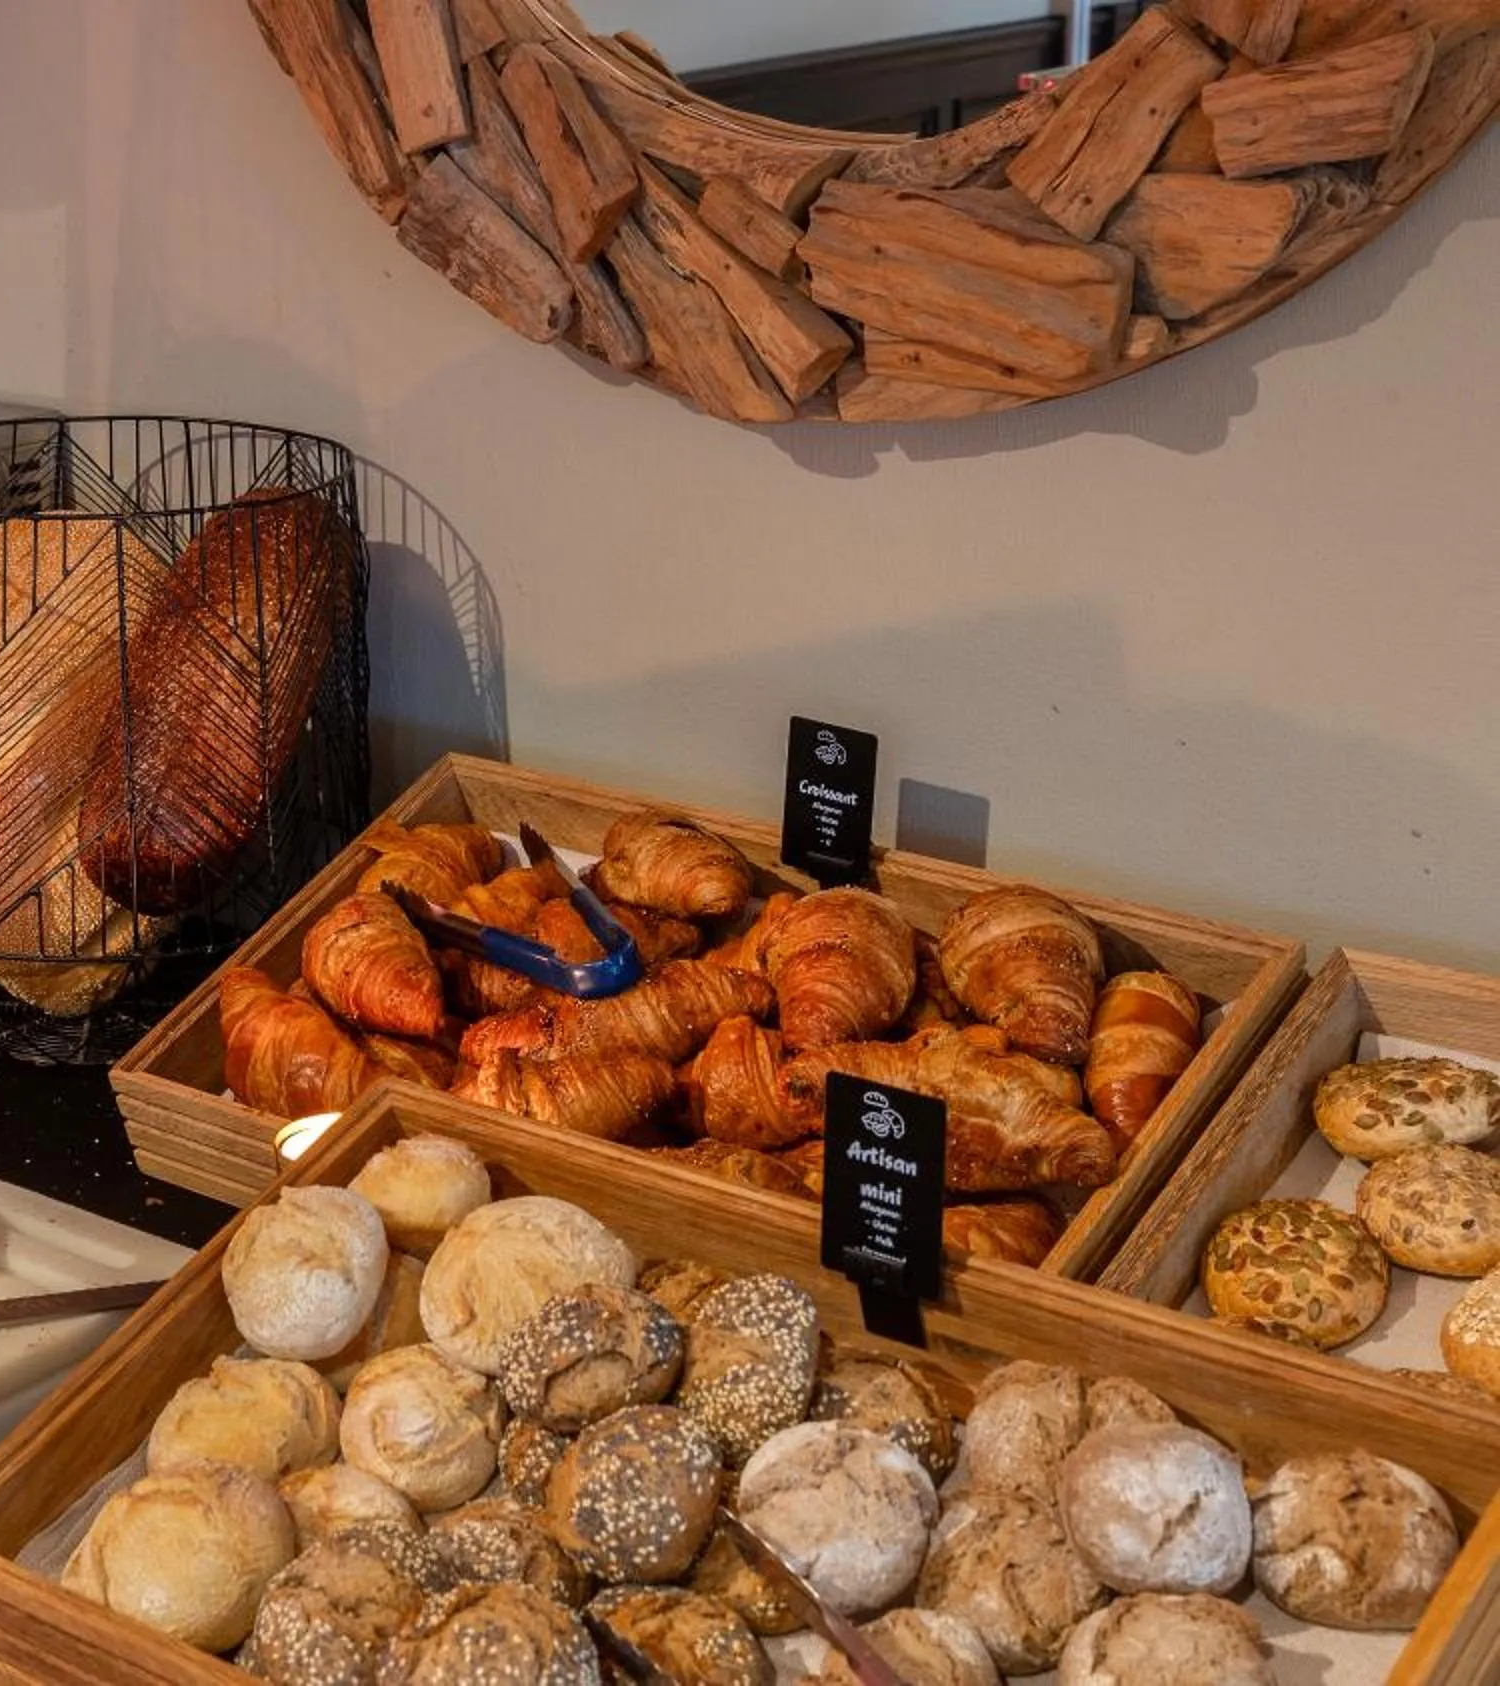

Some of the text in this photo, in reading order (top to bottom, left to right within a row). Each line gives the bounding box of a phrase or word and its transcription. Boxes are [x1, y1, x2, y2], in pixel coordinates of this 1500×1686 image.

[799, 779, 859, 806] Croissant
[846, 1140, 918, 1177] Artisan
[859, 1182, 903, 1206] mini
